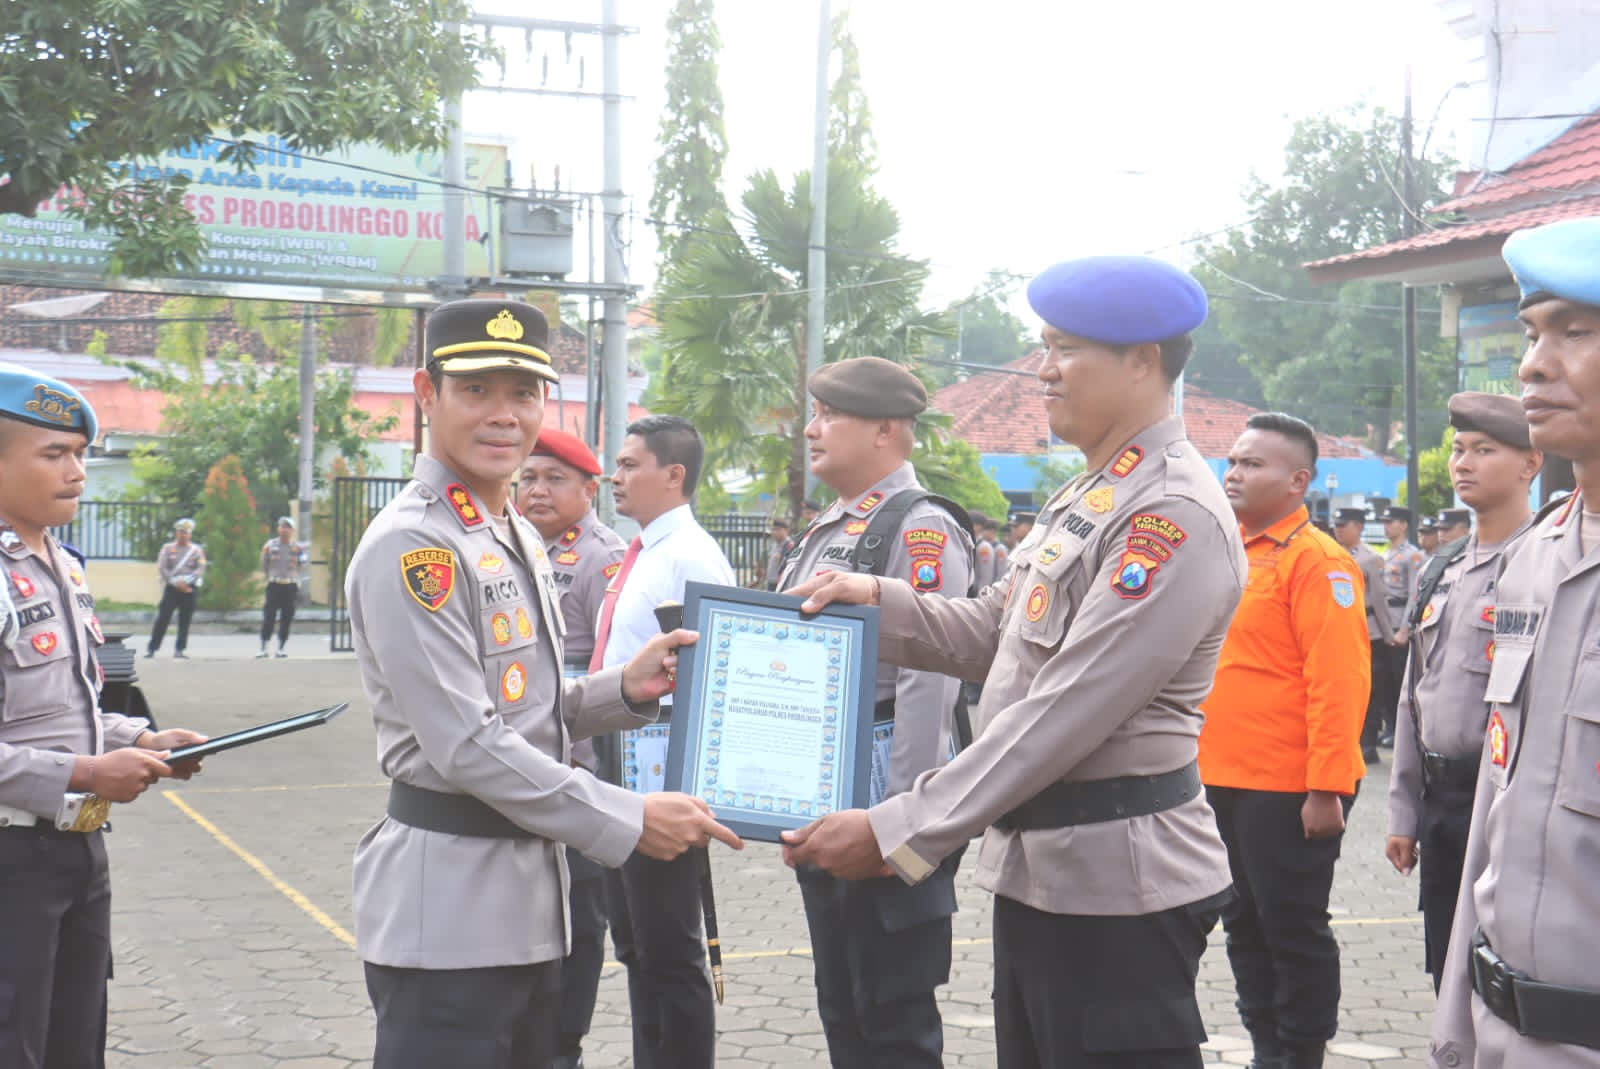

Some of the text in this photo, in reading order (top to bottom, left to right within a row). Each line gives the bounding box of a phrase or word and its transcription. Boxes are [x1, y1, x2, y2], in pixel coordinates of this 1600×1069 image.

[200, 167, 262, 189] Anda
[268, 172, 355, 198] Kepada
[360, 180, 417, 201] Kami
[223, 196, 409, 238] PROBOLINGGO
[416, 210, 481, 241] KOA
[6, 217, 73, 233] Menuju
[211, 231, 277, 248] Korupsi
[232, 249, 307, 265] Melayani
[1062, 511, 1096, 540] POLRI
[1134, 515, 1184, 541] POLRES
[405, 551, 450, 565] RESERSE
[484, 579, 519, 604] RICO
